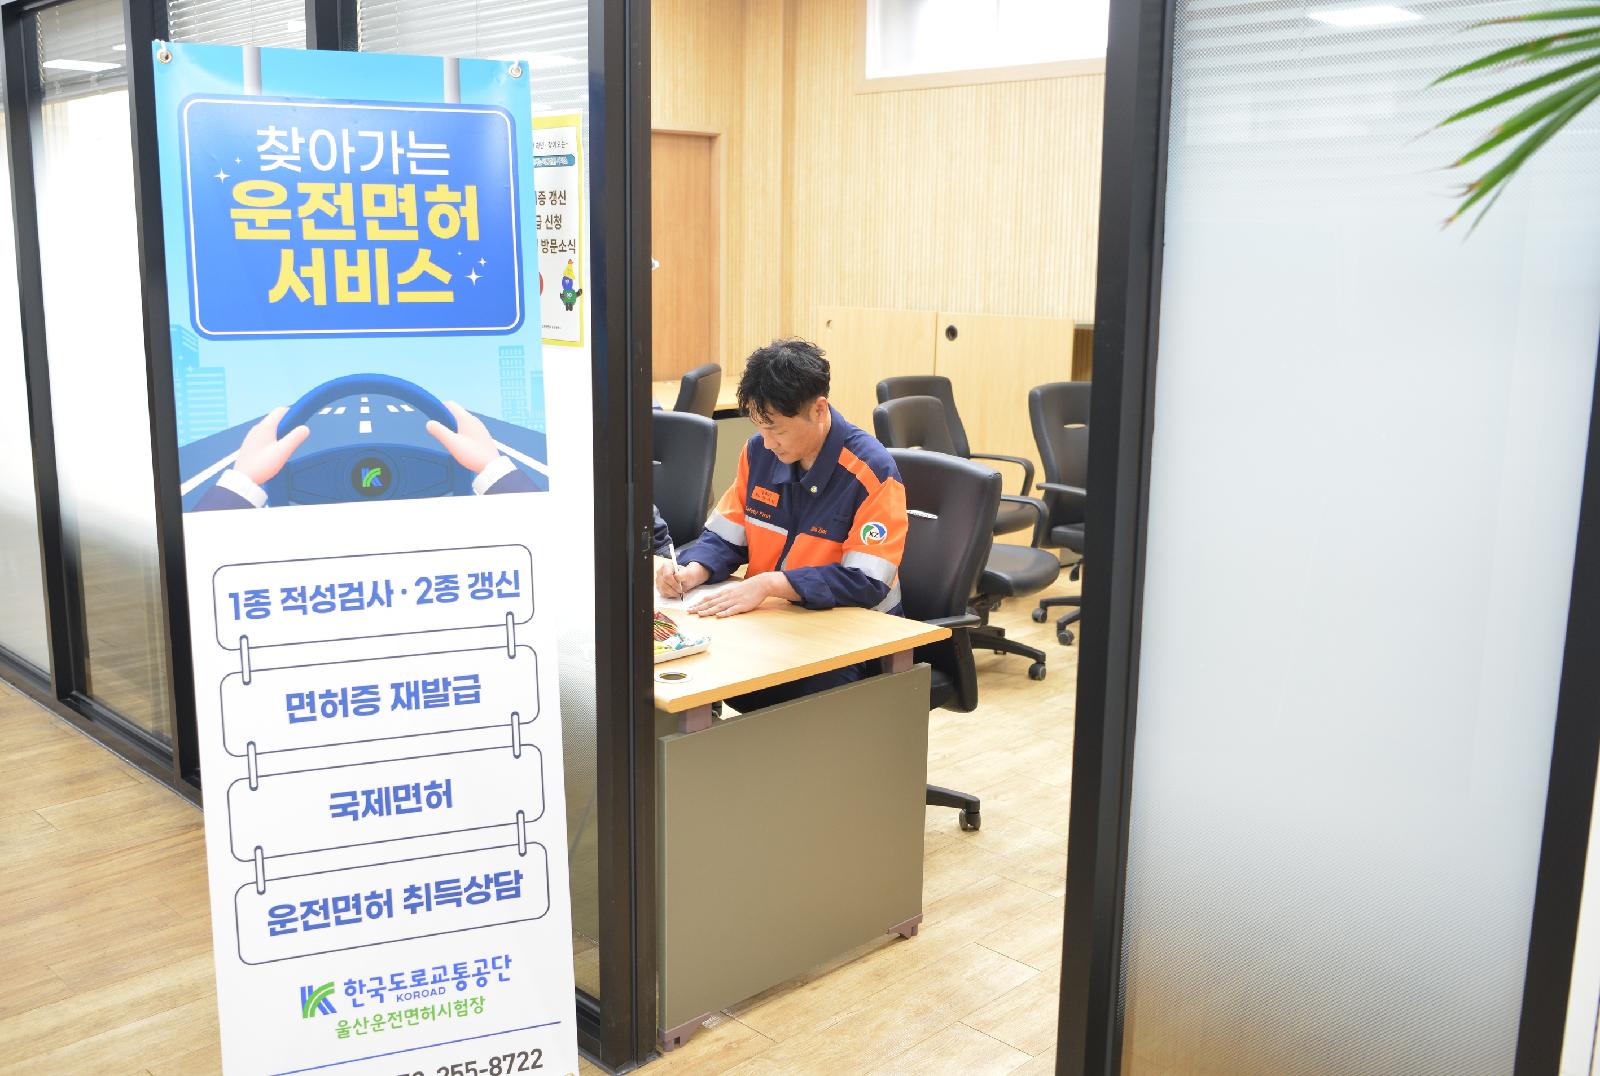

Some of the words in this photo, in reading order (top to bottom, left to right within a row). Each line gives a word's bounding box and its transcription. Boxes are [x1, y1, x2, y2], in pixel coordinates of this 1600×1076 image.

[256, 124, 452, 176] 찾아가는
[229, 179, 480, 241] 운전면허
[545, 214, 562, 230] 신청
[549, 189, 567, 206] 갱신
[540, 238, 576, 254] 방문소식
[268, 247, 455, 306] 서비스
[228, 588, 272, 620] 1종
[280, 579, 394, 616] 적성검사
[414, 573, 460, 605] 2종
[467, 569, 521, 600] 갱신
[286, 684, 381, 724] 면허증
[390, 673, 481, 712] 재발급
[329, 778, 453, 821] 국제면허
[267, 889, 394, 937] 운전면허
[402, 869, 524, 915] 취득상담
[343, 954, 513, 1008] 한국도로교통공단
[396, 986, 446, 1003] KOROAD
[335, 995, 486, 1039] 울산운전면허시험장
